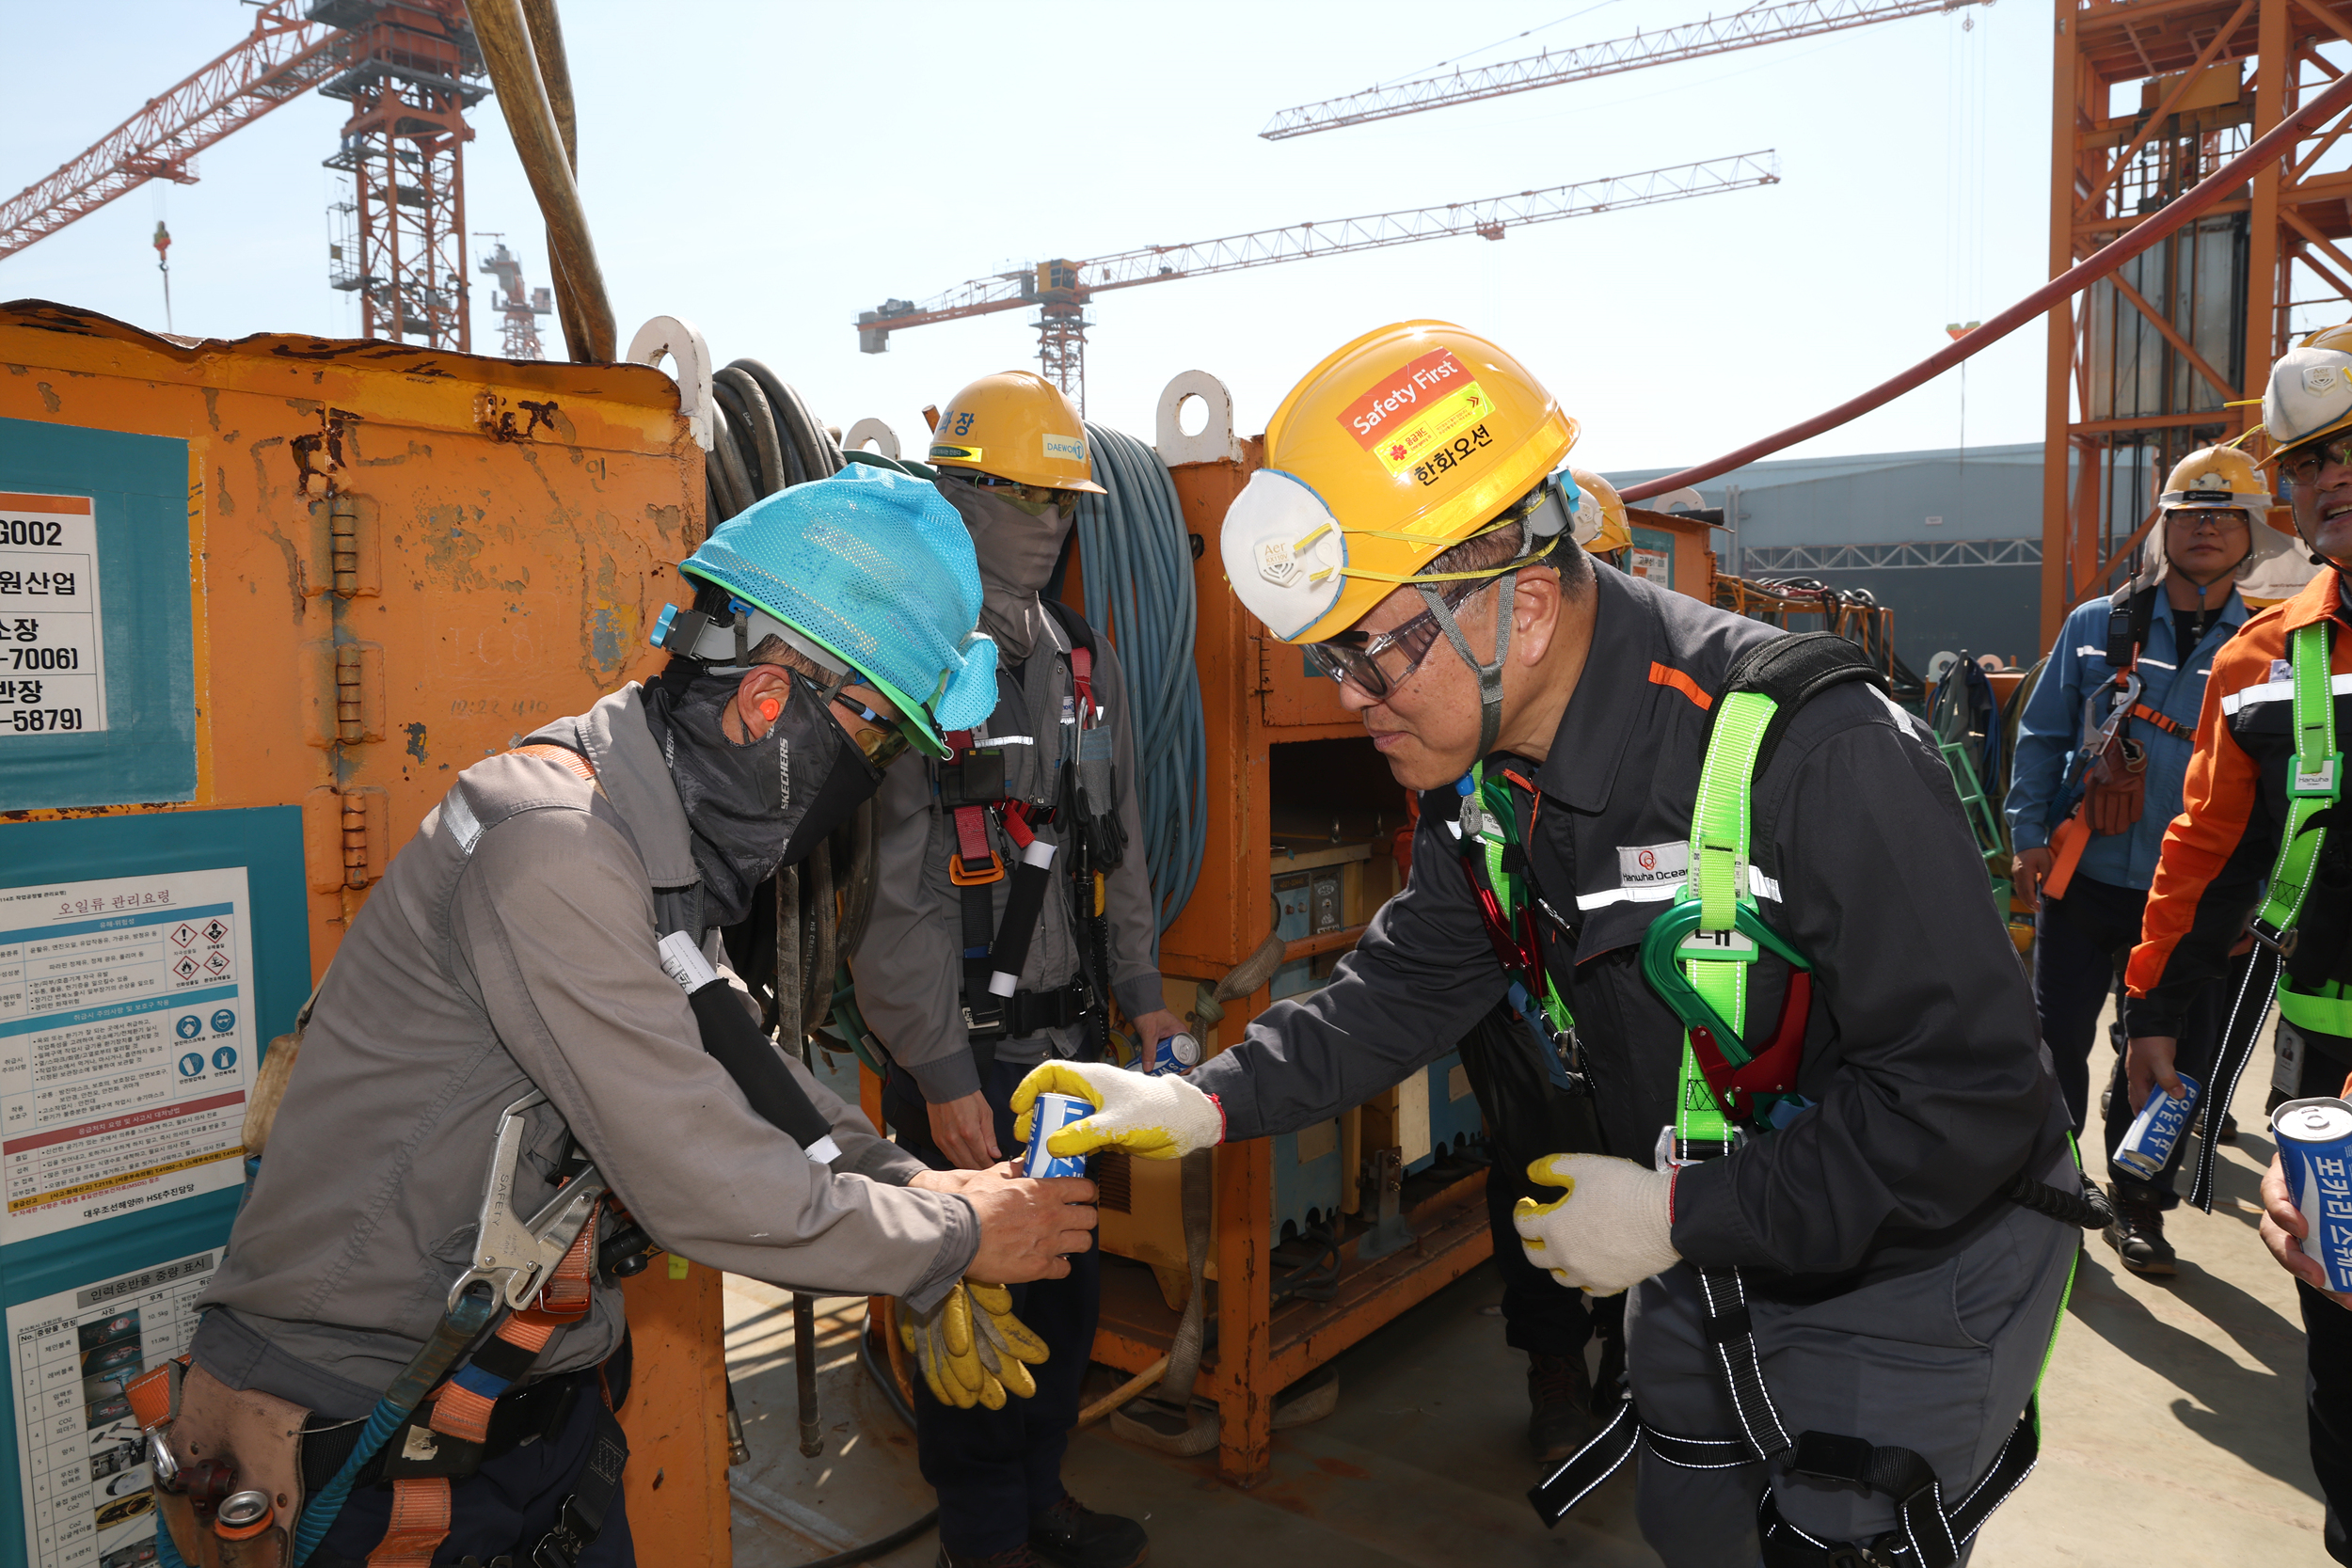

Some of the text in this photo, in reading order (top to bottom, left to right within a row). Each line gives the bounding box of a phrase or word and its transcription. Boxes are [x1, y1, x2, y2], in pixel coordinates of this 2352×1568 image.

[1353, 384, 1417, 436] Safety
[1412, 360, 1458, 390] First
[1414, 423, 1493, 486] 한화오션
[1265, 543, 1285, 555] Aer
[0, 571, 75, 595] 원산업
[778, 736, 789, 810] SKECHERS
[57, 889, 170, 915] 오일류 관리요령
[1622, 872, 1654, 882] Hanwha
[2154, 1085, 2198, 1162] POCARI
[492, 1174, 509, 1227] SAFETY
[2316, 1156, 2352, 1220] 포카리
[90, 1258, 204, 1301] 인력운반물 중량 표시
[21, 1332, 34, 1341] No.
[37, 1324, 58, 1337] 중량물
[61, 1319, 76, 1329] 명칭
[101, 1307, 115, 1317] 사진
[149, 1291, 163, 1302] 무게
